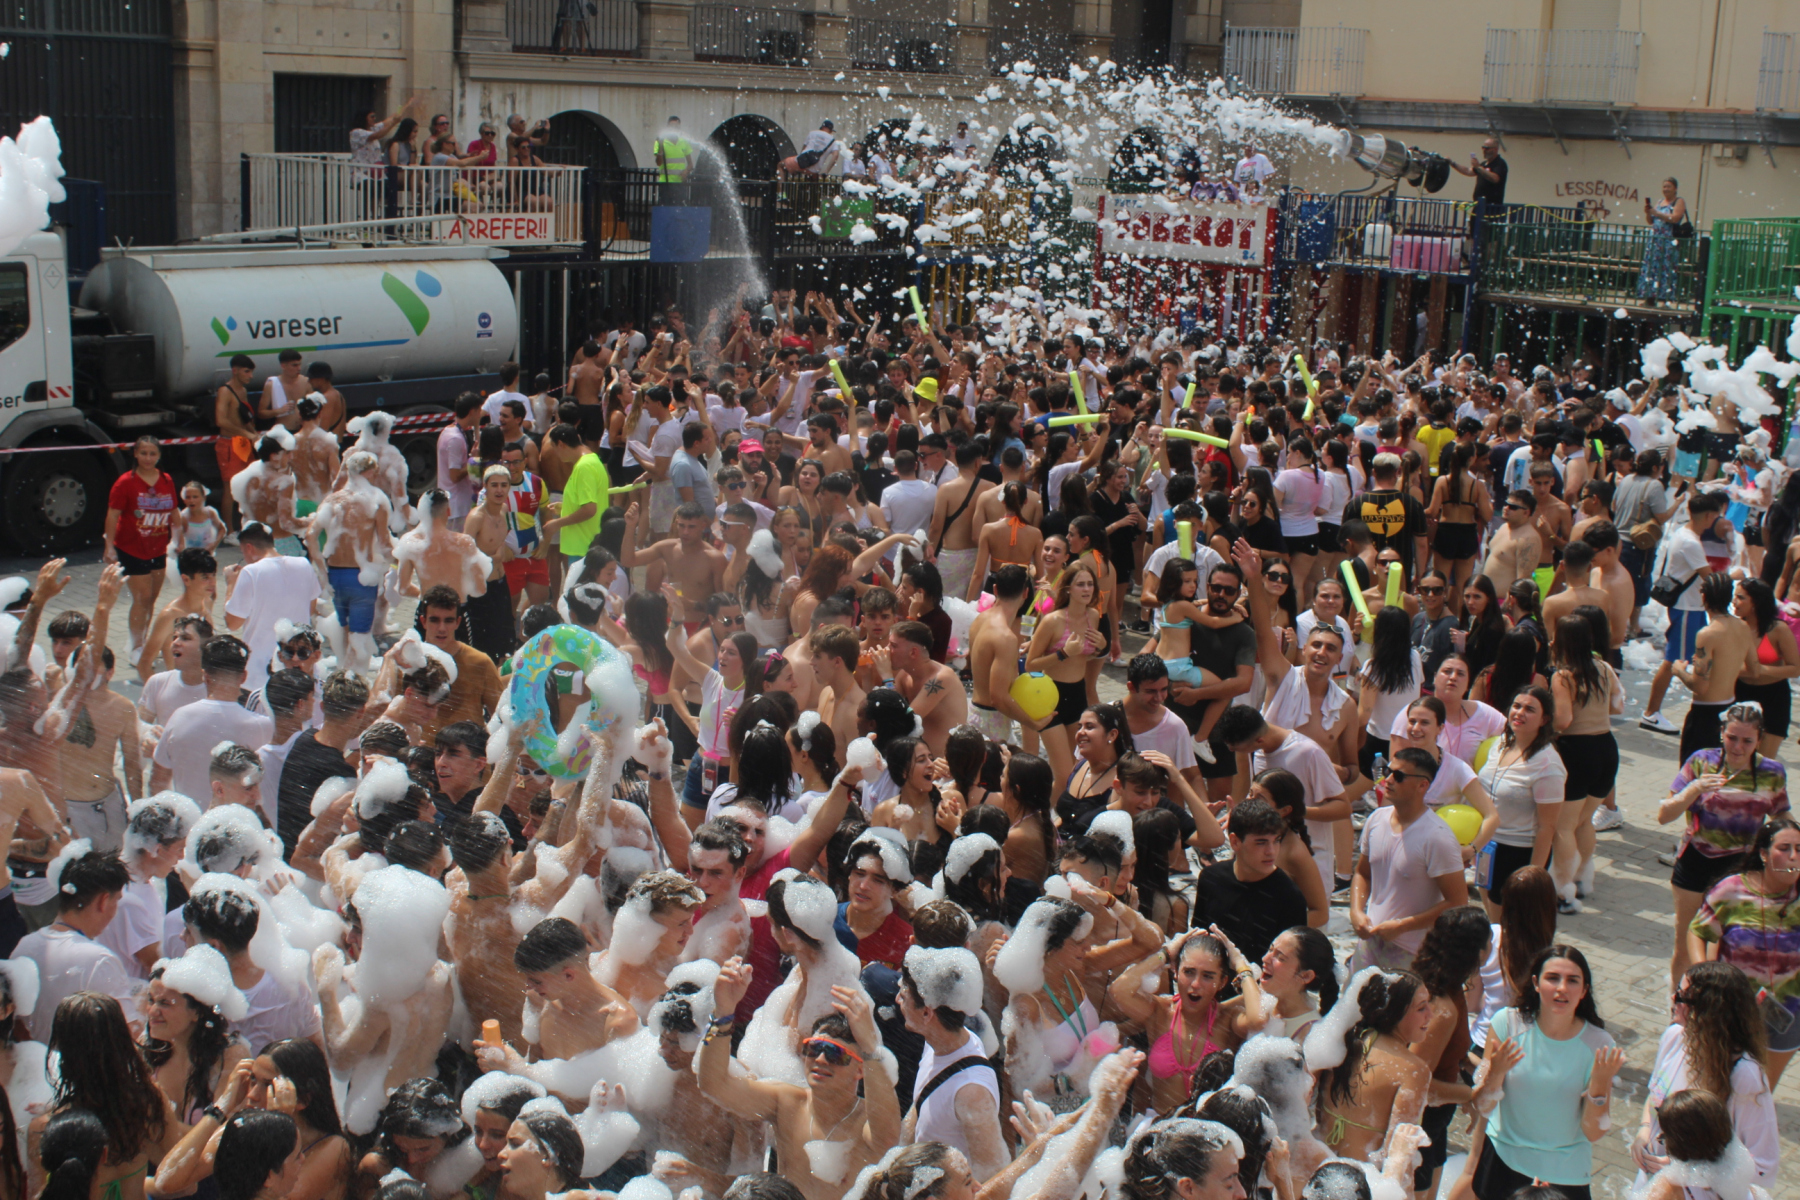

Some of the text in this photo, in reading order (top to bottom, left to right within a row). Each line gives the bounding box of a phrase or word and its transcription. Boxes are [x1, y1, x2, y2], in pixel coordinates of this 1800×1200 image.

[1242, 249, 1256, 261] 84
[246, 315, 342, 339] vareser
[0, 395, 22, 409] er
